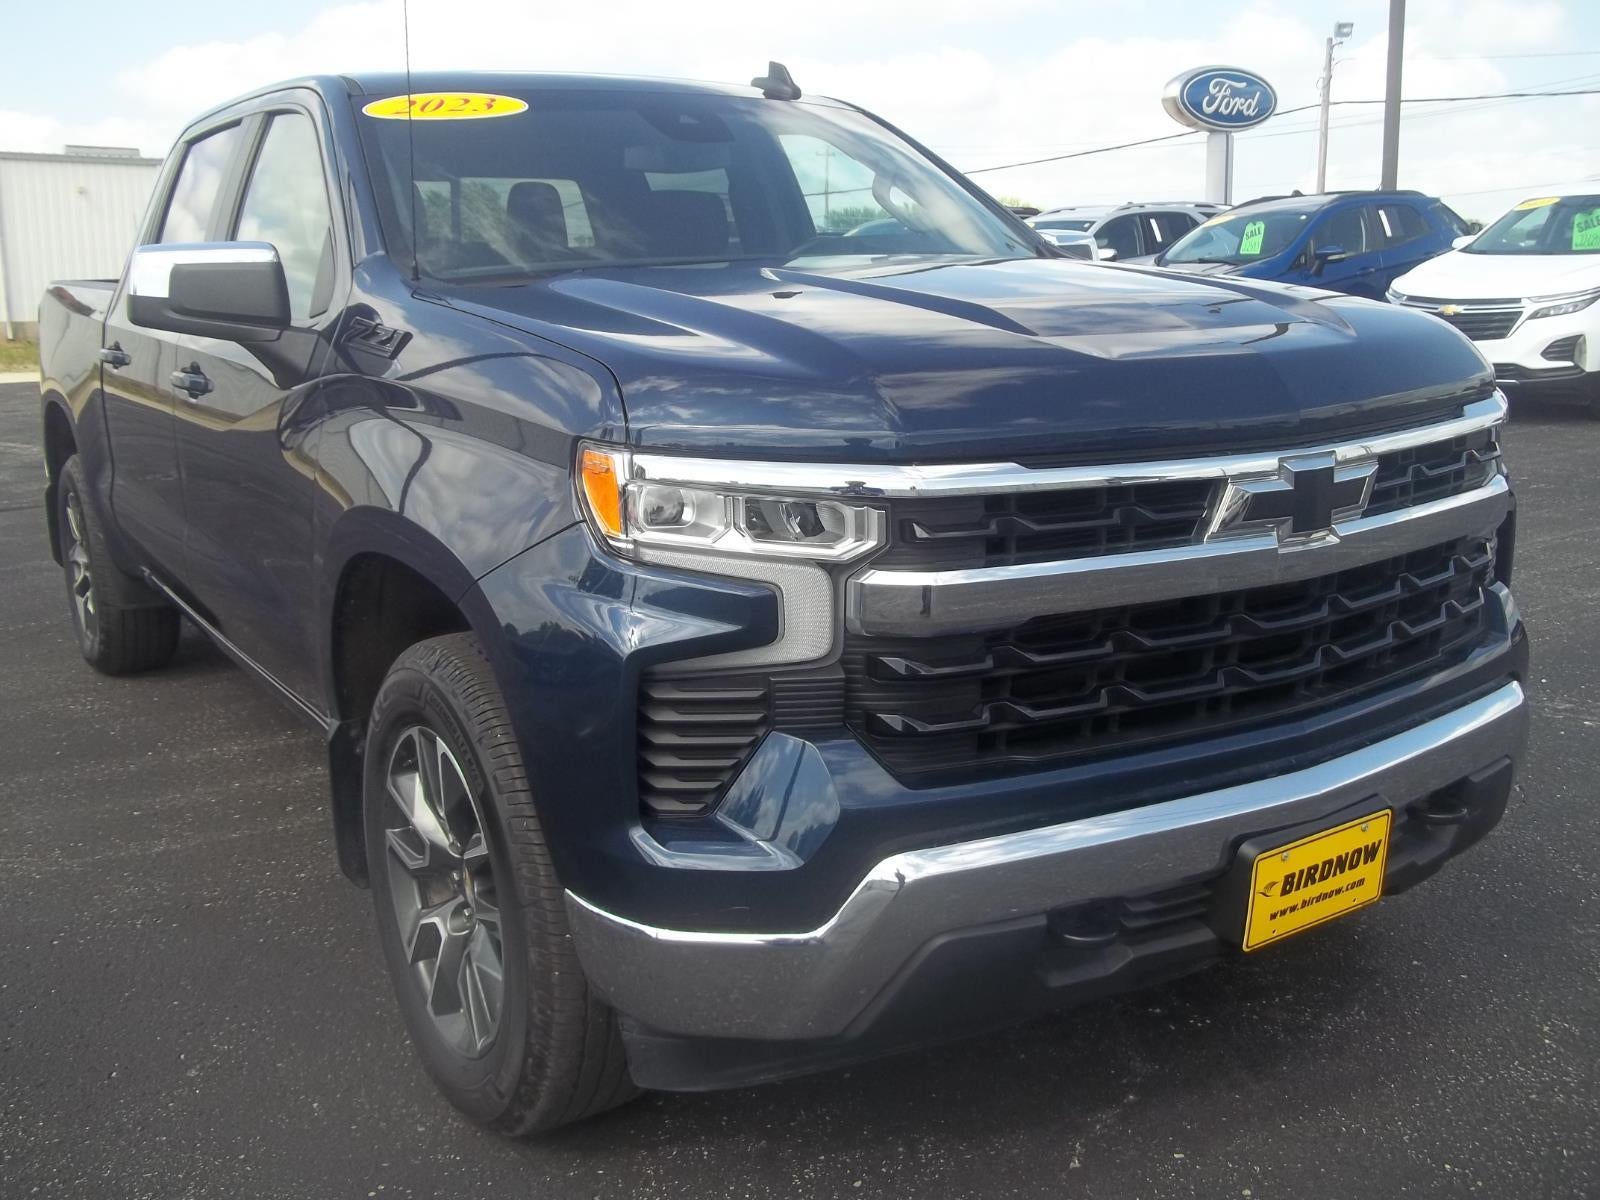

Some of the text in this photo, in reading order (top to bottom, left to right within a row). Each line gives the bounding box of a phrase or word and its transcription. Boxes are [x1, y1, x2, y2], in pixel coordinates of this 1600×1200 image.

[391, 98, 497, 115] 2023
[1202, 78, 1260, 117] Ford
[1280, 839, 1382, 897] BIRDNOW
[1269, 877, 1366, 921] www.birdnow.com
